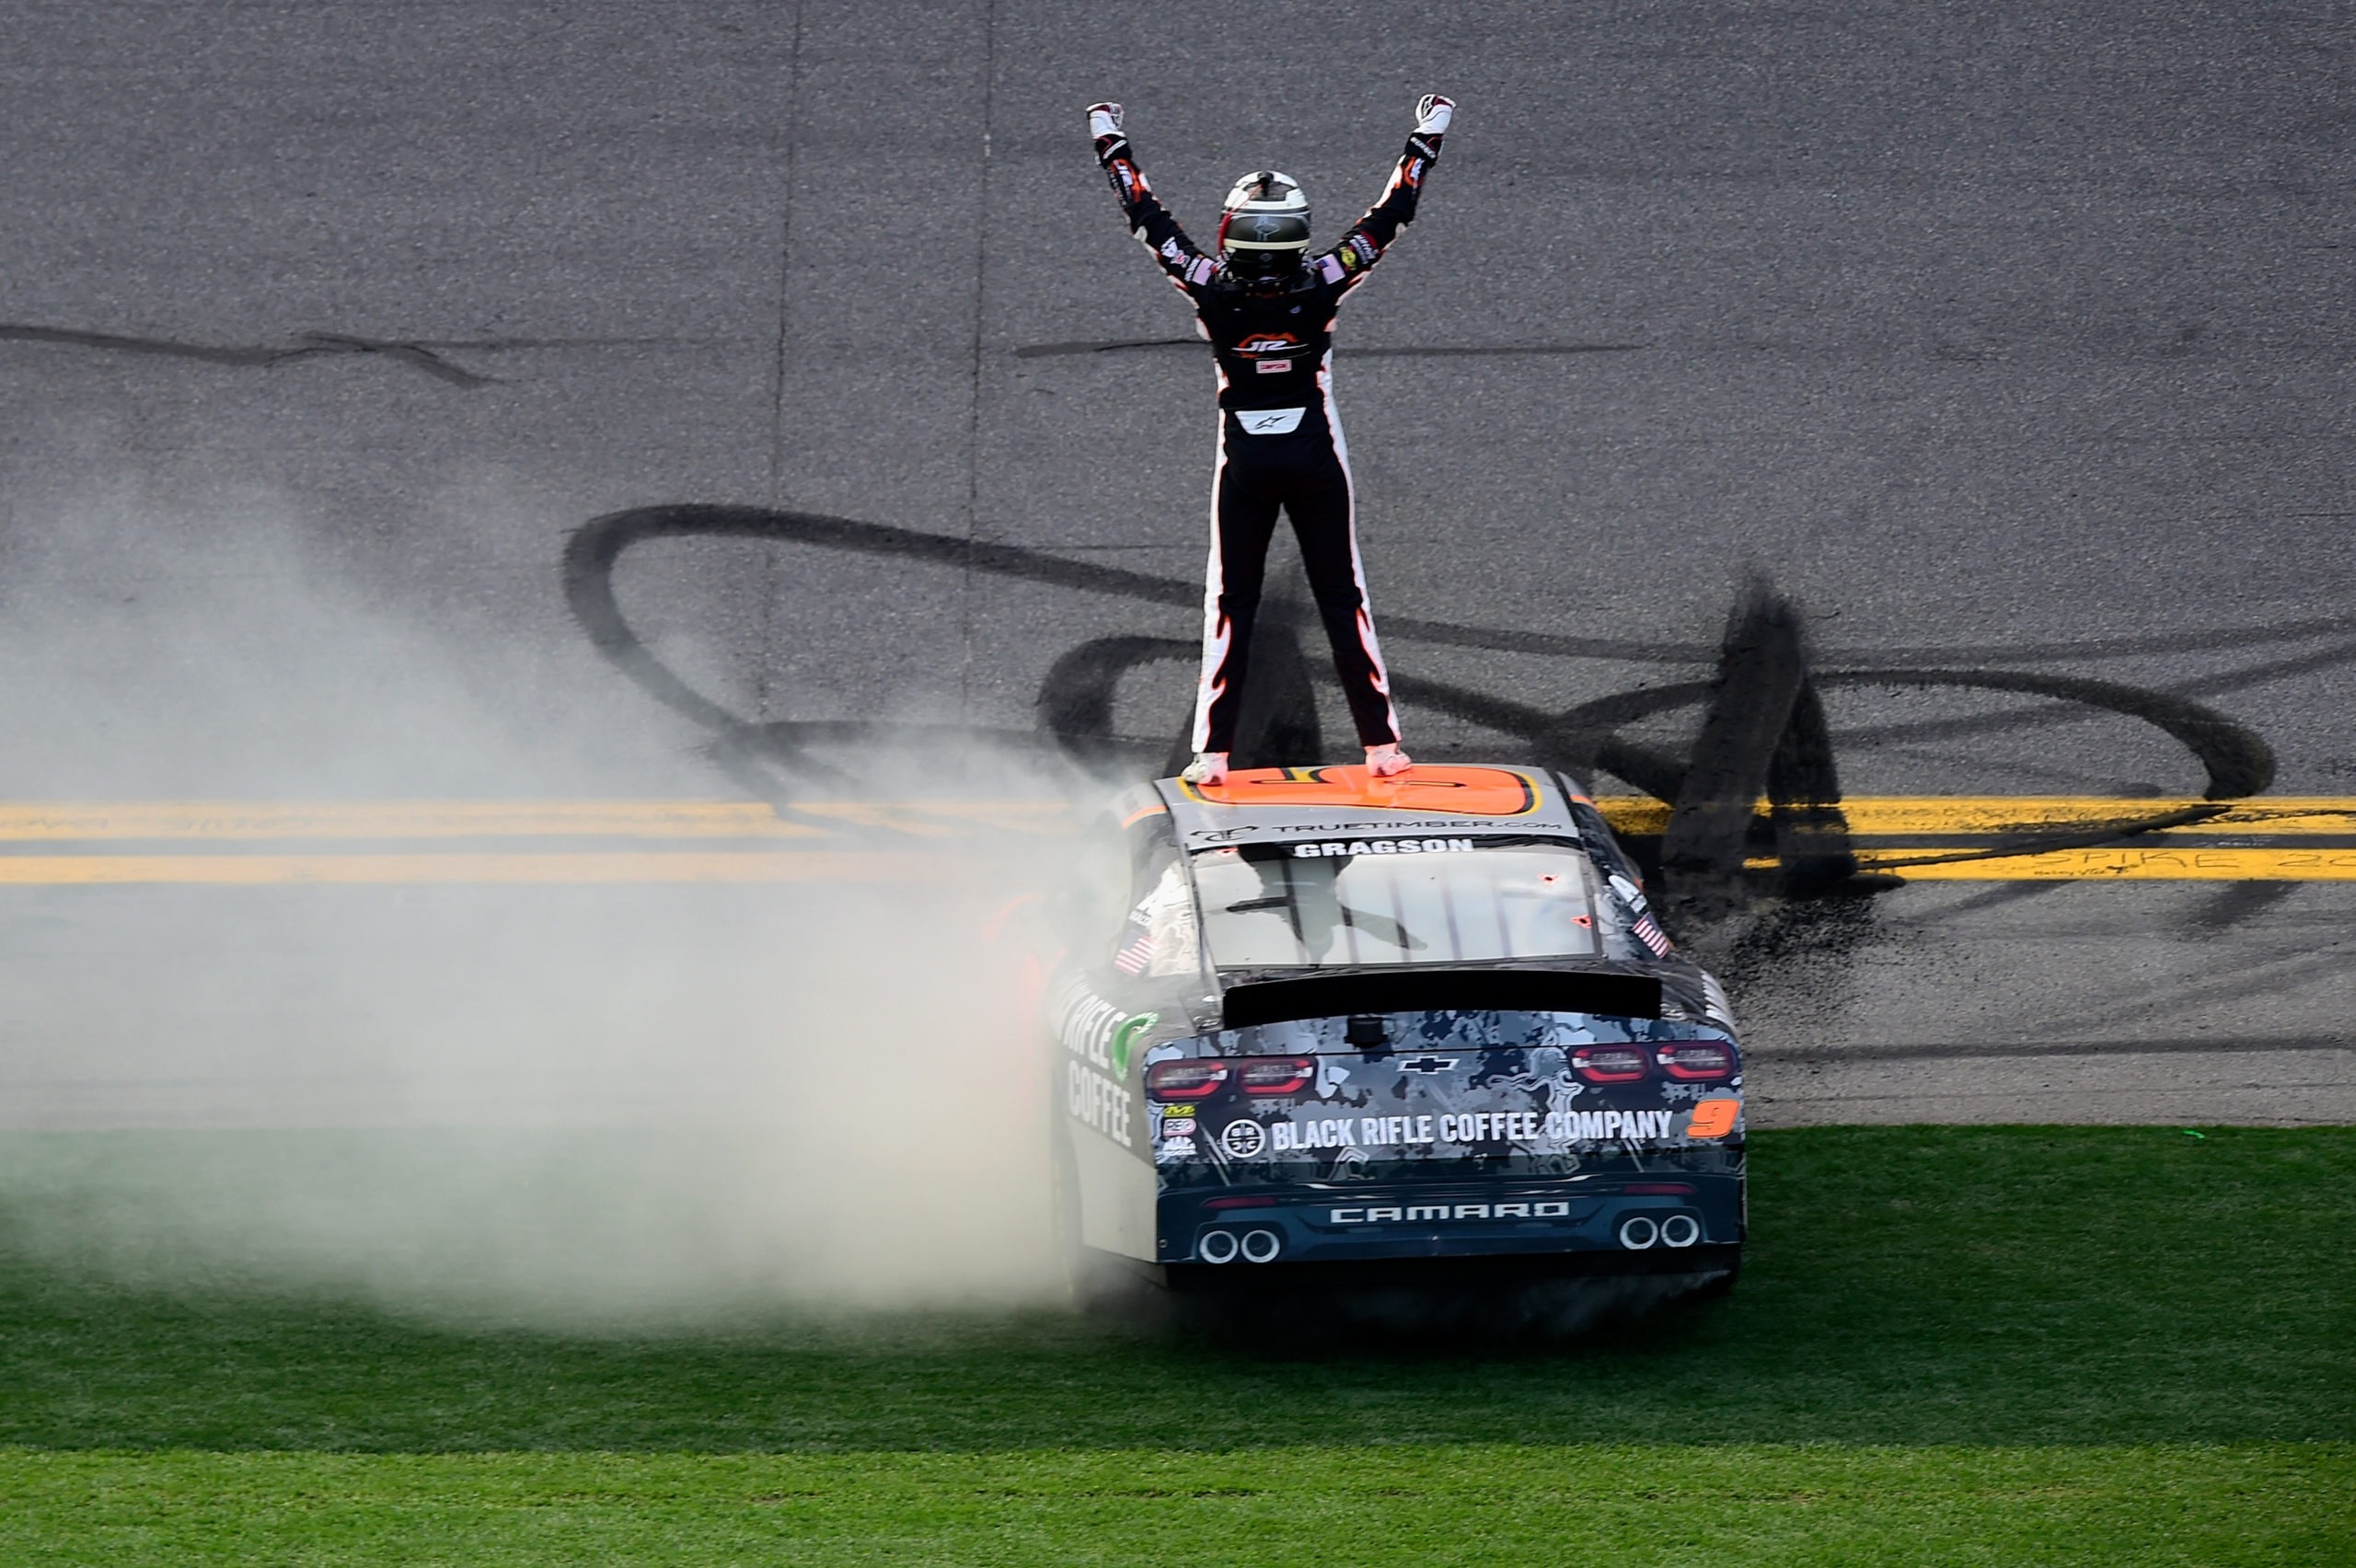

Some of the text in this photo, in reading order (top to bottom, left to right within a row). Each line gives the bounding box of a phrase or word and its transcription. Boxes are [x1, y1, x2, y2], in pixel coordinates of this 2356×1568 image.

[1271, 819, 1563, 832] TRUETIMBER.COM
[1294, 838, 1473, 859] GRAGSON
[1068, 1059, 1132, 1147] COFFEE
[1272, 1118, 1357, 1150] BLACK
[1360, 1114, 1435, 1147] RIFLE
[1438, 1111, 1540, 1143] COFFEE
[1545, 1110, 1674, 1140] COMPANY
[1687, 1099, 1740, 1138] 9
[1331, 1202, 1569, 1224] CAMARO
